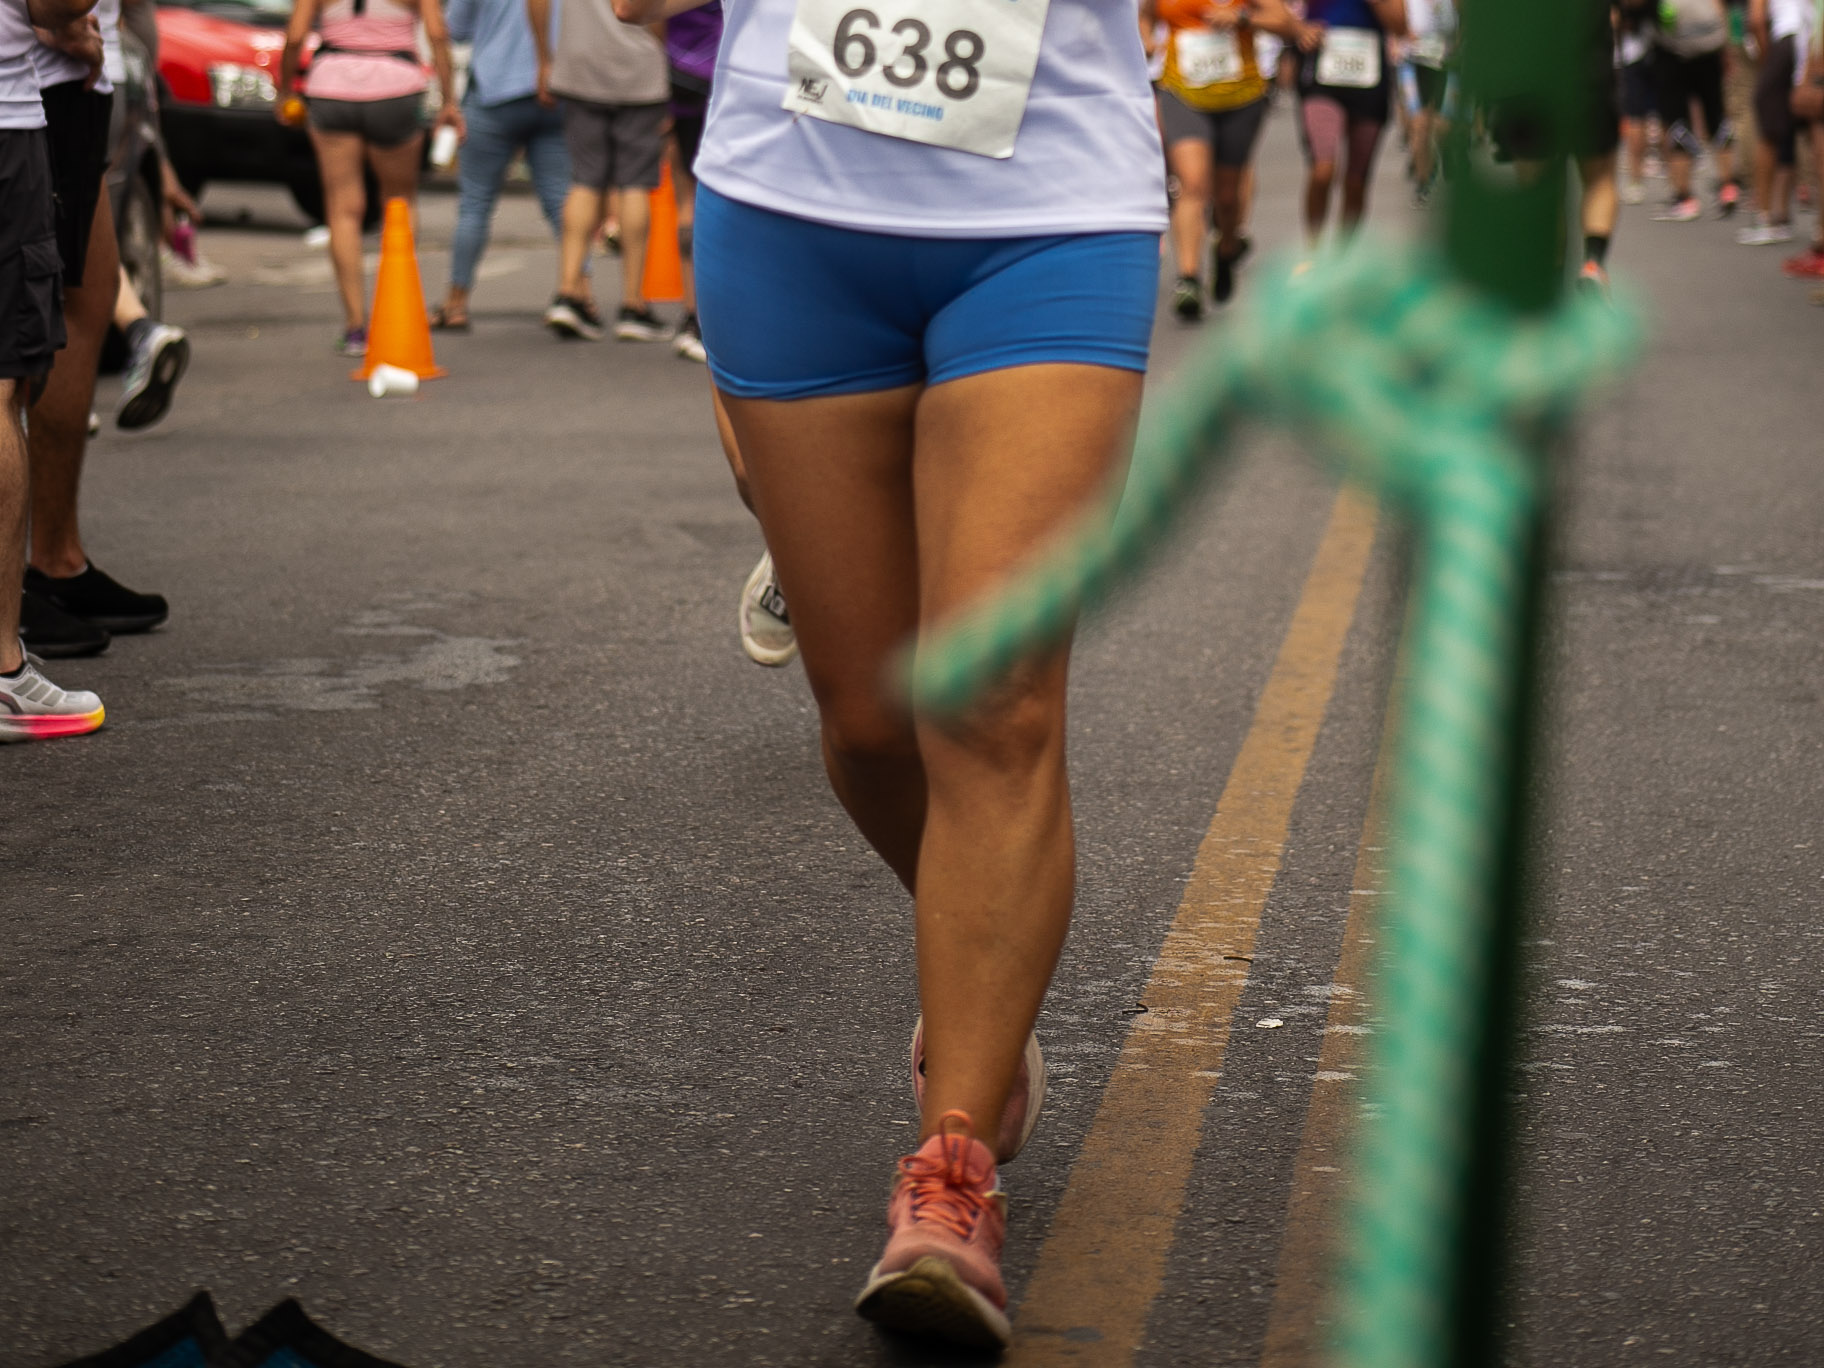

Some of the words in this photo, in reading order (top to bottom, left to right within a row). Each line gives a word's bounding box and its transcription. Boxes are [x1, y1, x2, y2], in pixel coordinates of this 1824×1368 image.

[833, 8, 985, 100] 638
[847, 88, 867, 105] DIA
[872, 93, 892, 109] DEL
[896, 98, 944, 121] VECINO
